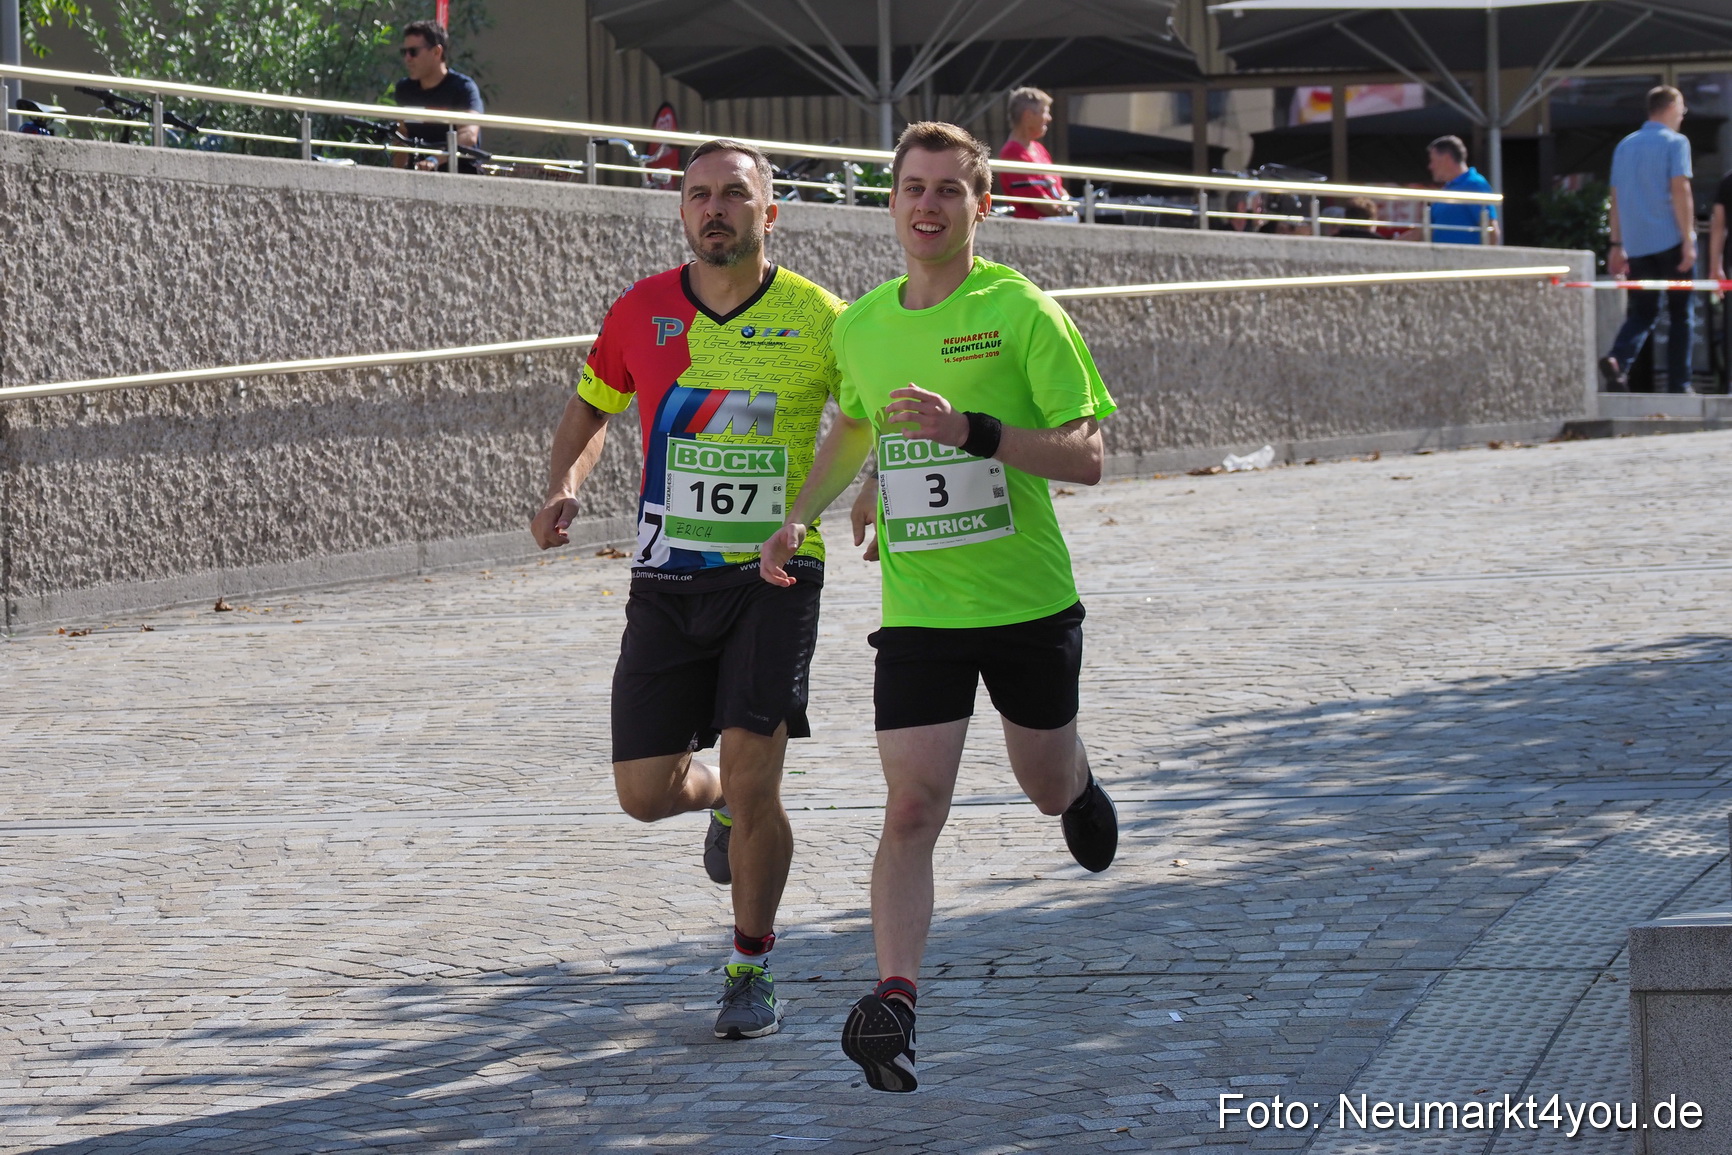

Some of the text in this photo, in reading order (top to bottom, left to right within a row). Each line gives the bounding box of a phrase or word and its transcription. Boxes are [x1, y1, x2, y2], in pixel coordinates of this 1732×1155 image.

[941, 339, 1003, 356] ELEMENTELAUF
[943, 330, 1000, 345] NEUMARKTER
[952, 353, 985, 363] September
[985, 350, 1000, 358] 2019
[675, 444, 776, 472] BOCK
[887, 439, 973, 466] BOC
[989, 467, 1000, 475] E6
[689, 481, 759, 515] 167
[925, 473, 949, 508] 3
[676, 521, 713, 539] ERICH
[905, 513, 988, 538] PATRICK
